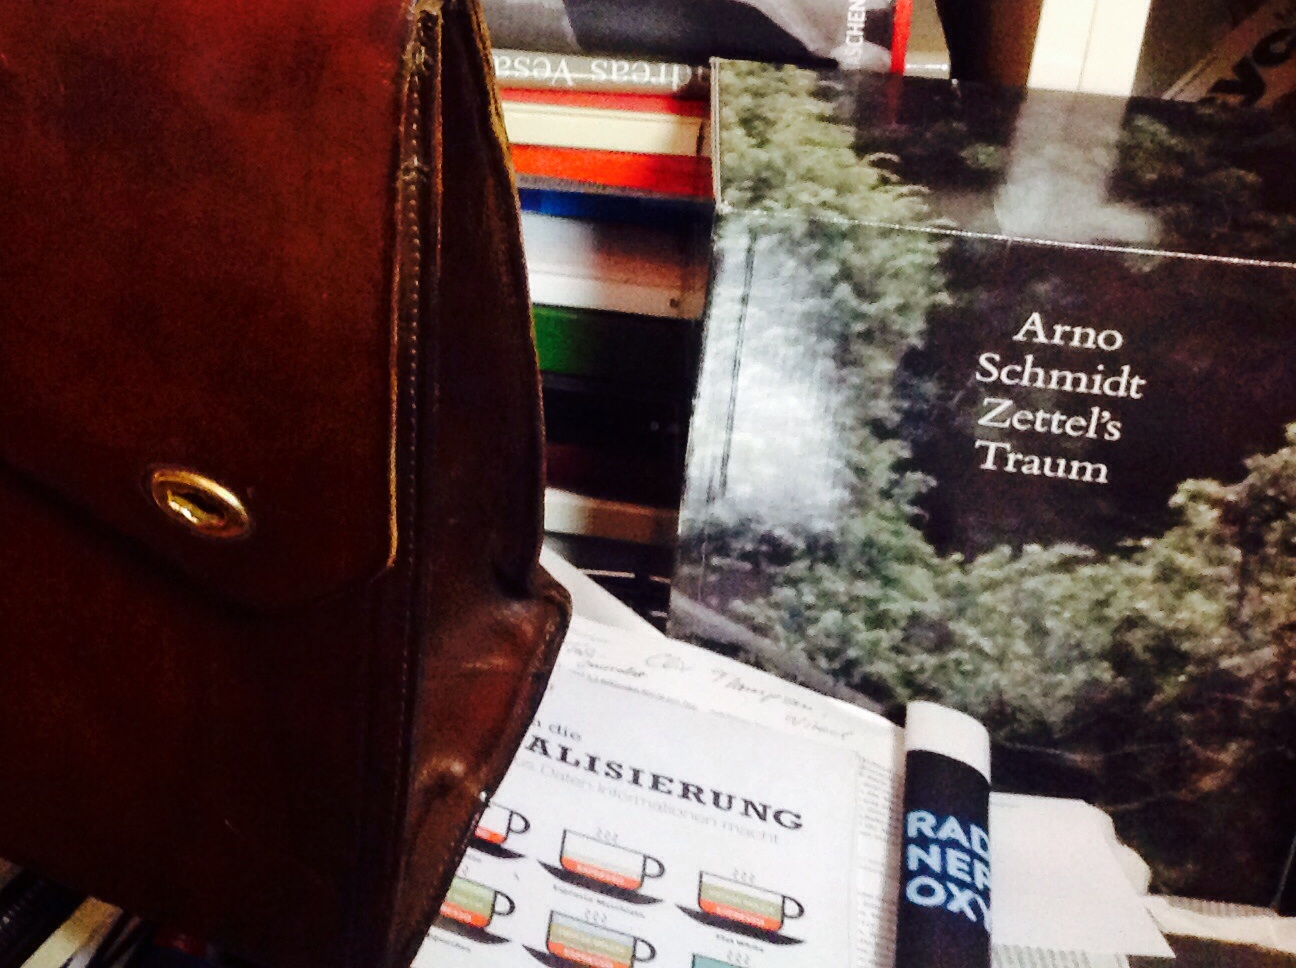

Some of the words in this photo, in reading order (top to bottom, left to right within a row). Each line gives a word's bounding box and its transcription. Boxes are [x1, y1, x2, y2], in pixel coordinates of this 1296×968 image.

[493, 55, 575, 88] Vesa
[591, 59, 703, 92] dreas
[1013, 310, 1125, 352] Arno
[975, 352, 1147, 401] Schmidt
[975, 440, 1110, 484] Traum
[549, 720, 582, 742] die
[524, 733, 804, 832] ALISIERUNG
[906, 809, 990, 862] RAD
